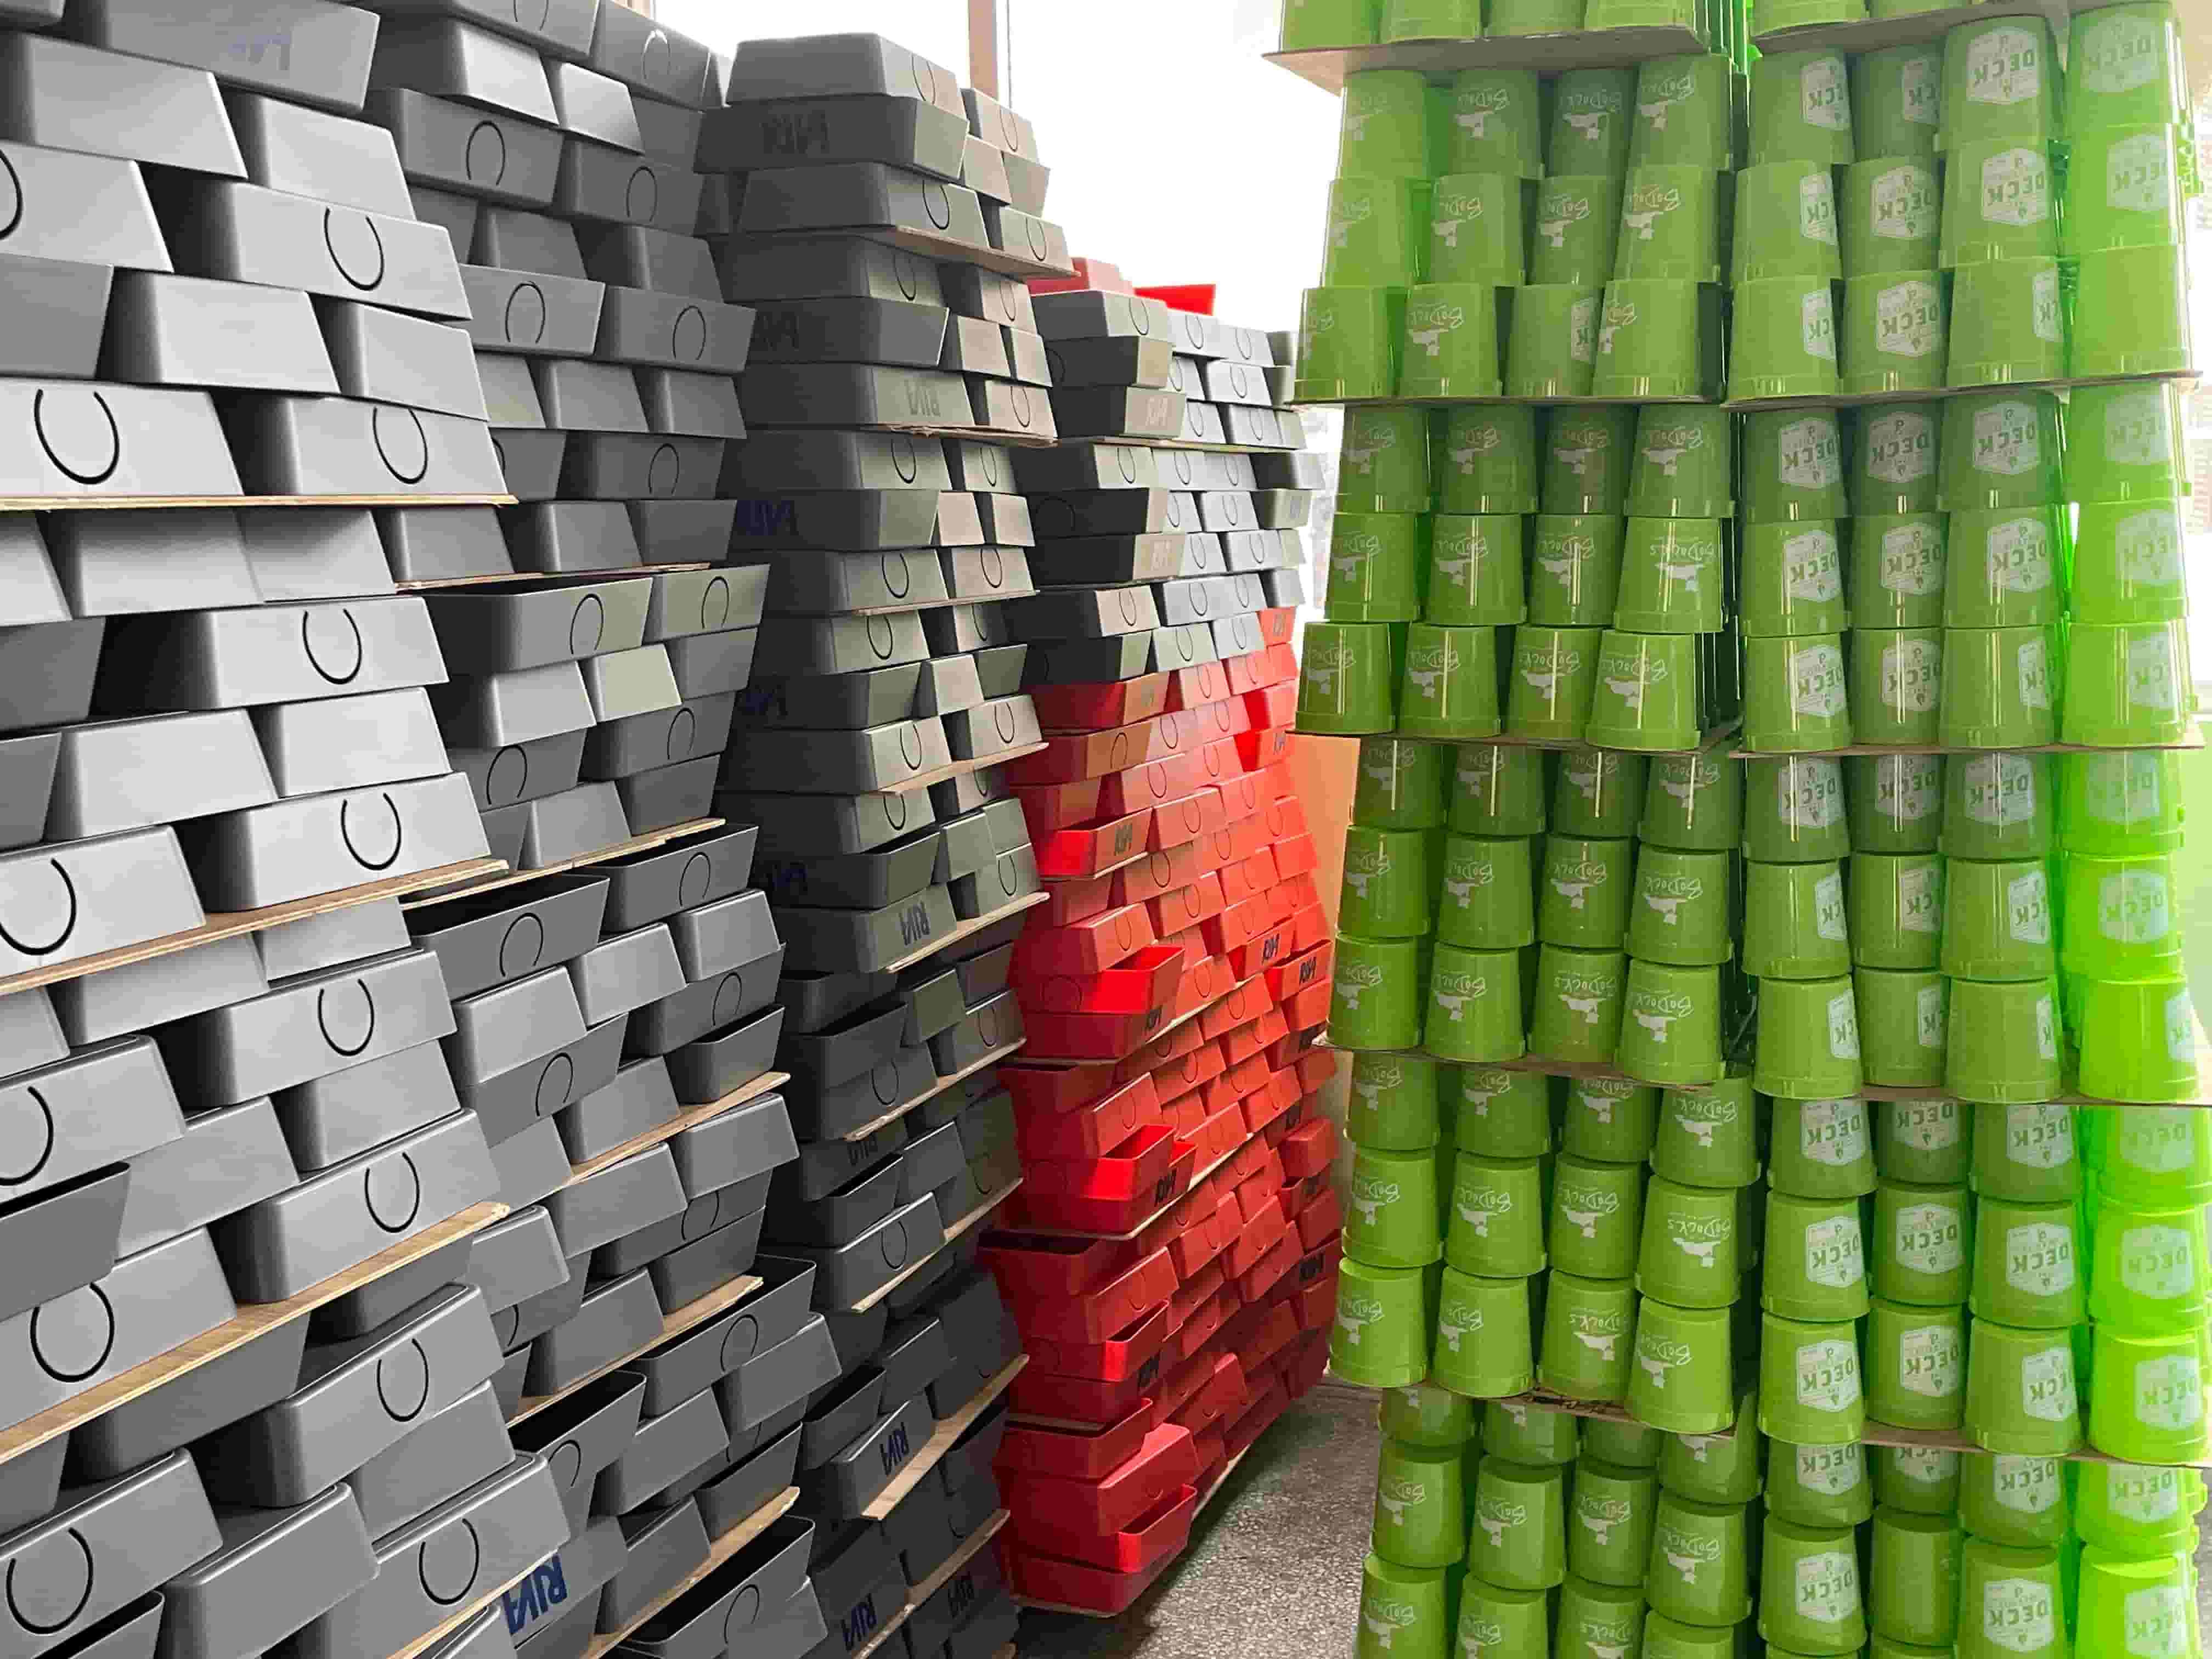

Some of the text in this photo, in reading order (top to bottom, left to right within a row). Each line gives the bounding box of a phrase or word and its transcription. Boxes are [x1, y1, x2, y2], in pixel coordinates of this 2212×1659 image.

[1973, 50, 2036, 83] DECK
[1987, 174, 2044, 204] DECK
[1878, 191, 1931, 219] DECK
[1882, 304, 1938, 337] DECK
[1871, 435, 1929, 465] DECK
[1978, 422, 2036, 455] DECK
[1785, 443, 1834, 469] DECK
[1790, 554, 1836, 583] DECK
[1886, 545, 1942, 574] DECK
[1994, 543, 2046, 573] DECK
[1797, 667, 1842, 696] DECK
[898, 900, 931, 948] RIVA
[1896, 1102, 1954, 1127] DECK
[1808, 1115, 1861, 1146] DECK
[2013, 1115, 2069, 1146] DECK
[1901, 1222, 1957, 1250] DECK
[1813, 1237, 1860, 1268] DECK
[2012, 1244, 2069, 1274] DECK
[2128, 1248, 2187, 1273] DECK
[1803, 1358, 1854, 1390] DECK
[1905, 1343, 1959, 1375] DECK
[2144, 1381, 2199, 1406] DECK
[879, 1421, 909, 1476] RIVA
[1802, 1444, 1857, 1470] DECK
[2001, 1461, 2055, 1491] DECK
[2115, 1469, 2172, 1499] DECK
[503, 1555, 567, 1637] RIVA
[1801, 1570, 1853, 1602] DECK
[840, 1593, 877, 1652] RIVA
[1989, 1600, 2048, 1629] DECK
